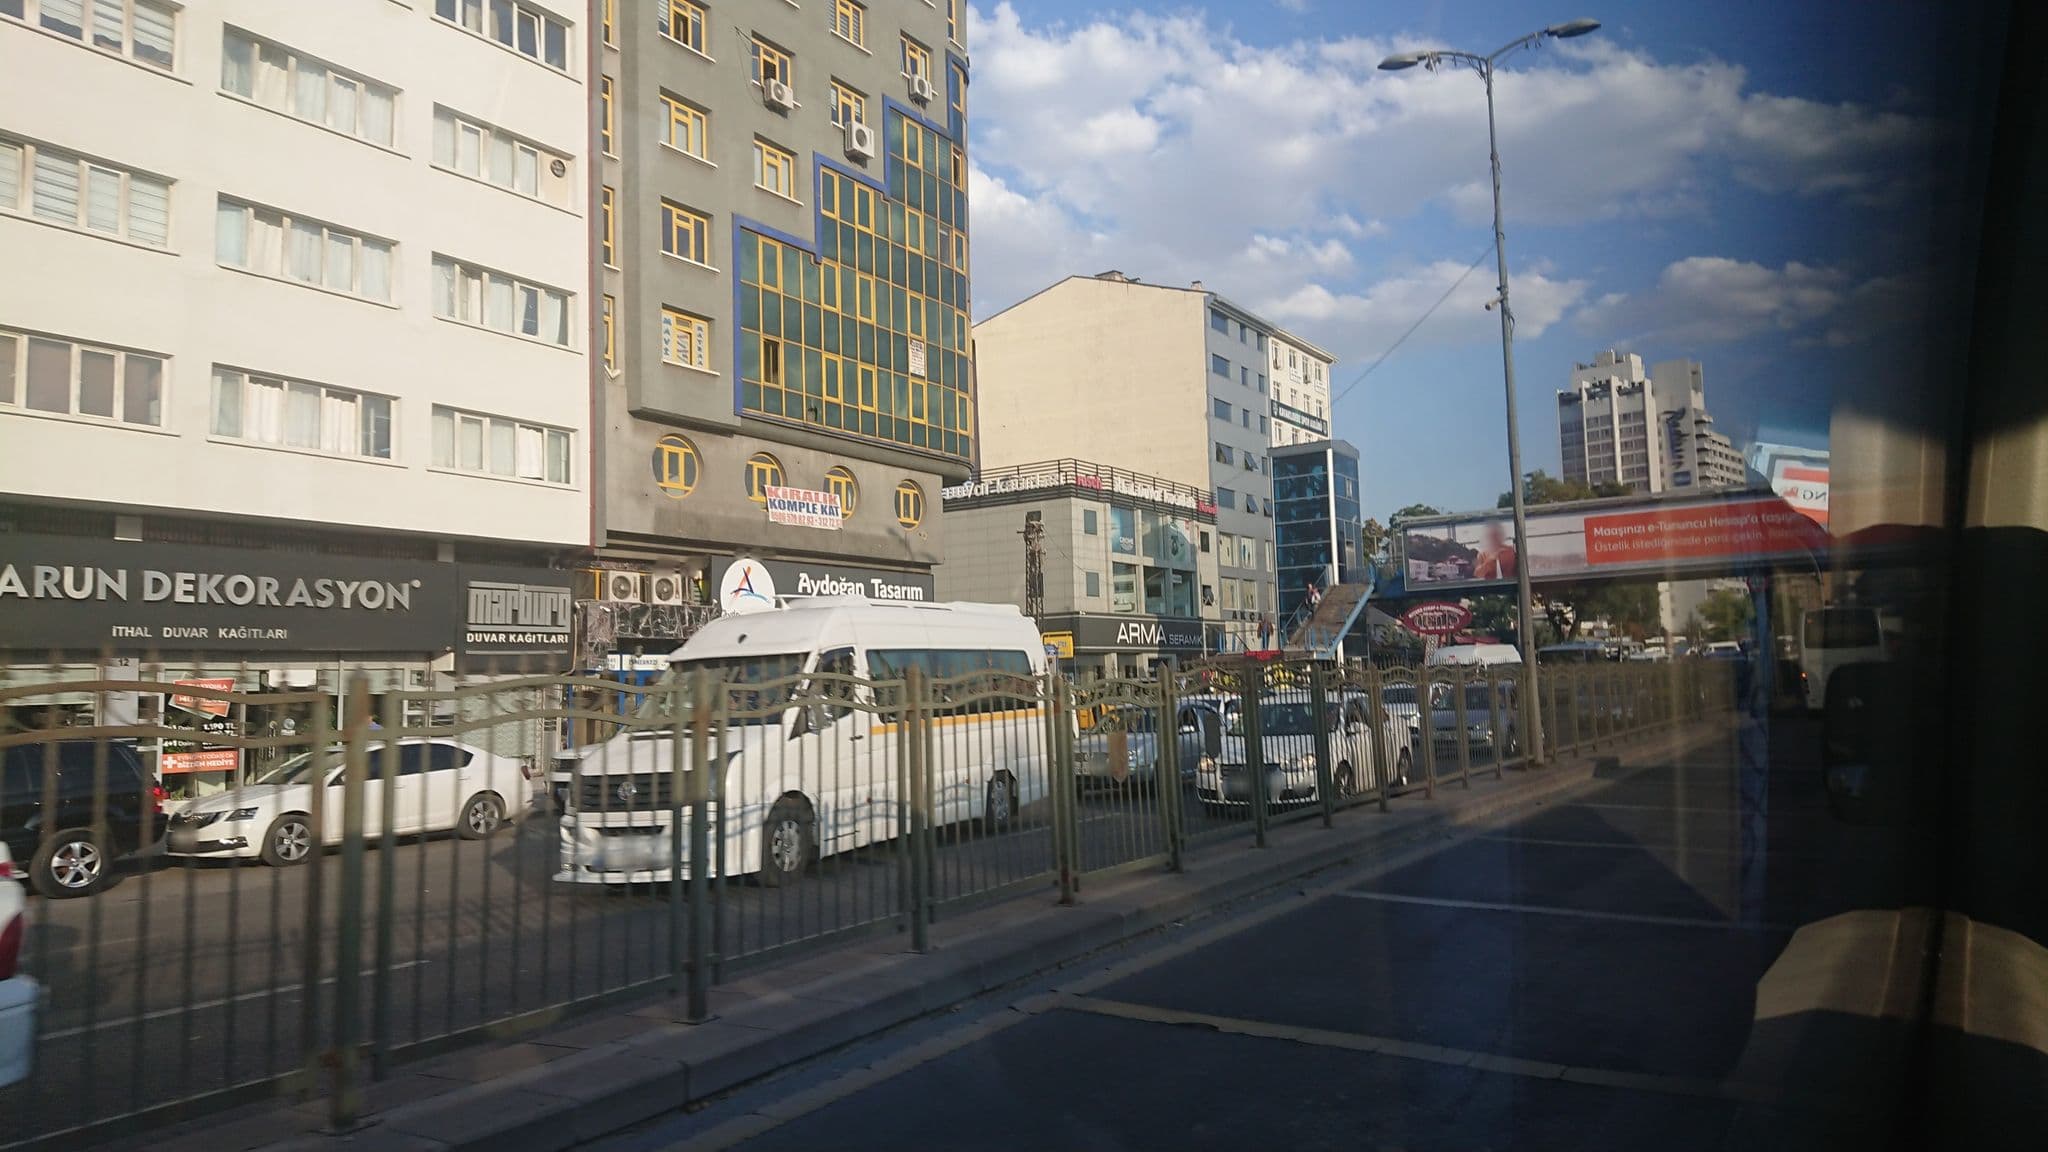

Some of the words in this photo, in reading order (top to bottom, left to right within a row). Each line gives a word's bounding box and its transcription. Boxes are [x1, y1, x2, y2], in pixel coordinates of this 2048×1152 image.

[768, 499, 818, 514] KOMPLE
[820, 504, 840, 517] KAT
[0, 563, 127, 601] ARUN
[798, 572, 864, 596] Aydoğan
[871, 578, 923, 600] Tasarım
[162, 626, 209, 639] DUVAR
[218, 625, 288, 640] KAĞITLARI
[466, 632, 506, 643] DUVAR
[508, 631, 569, 644] KAĞITLARI
[1116, 621, 1168, 645] ARMA
[119, 657, 130, 667] 12
